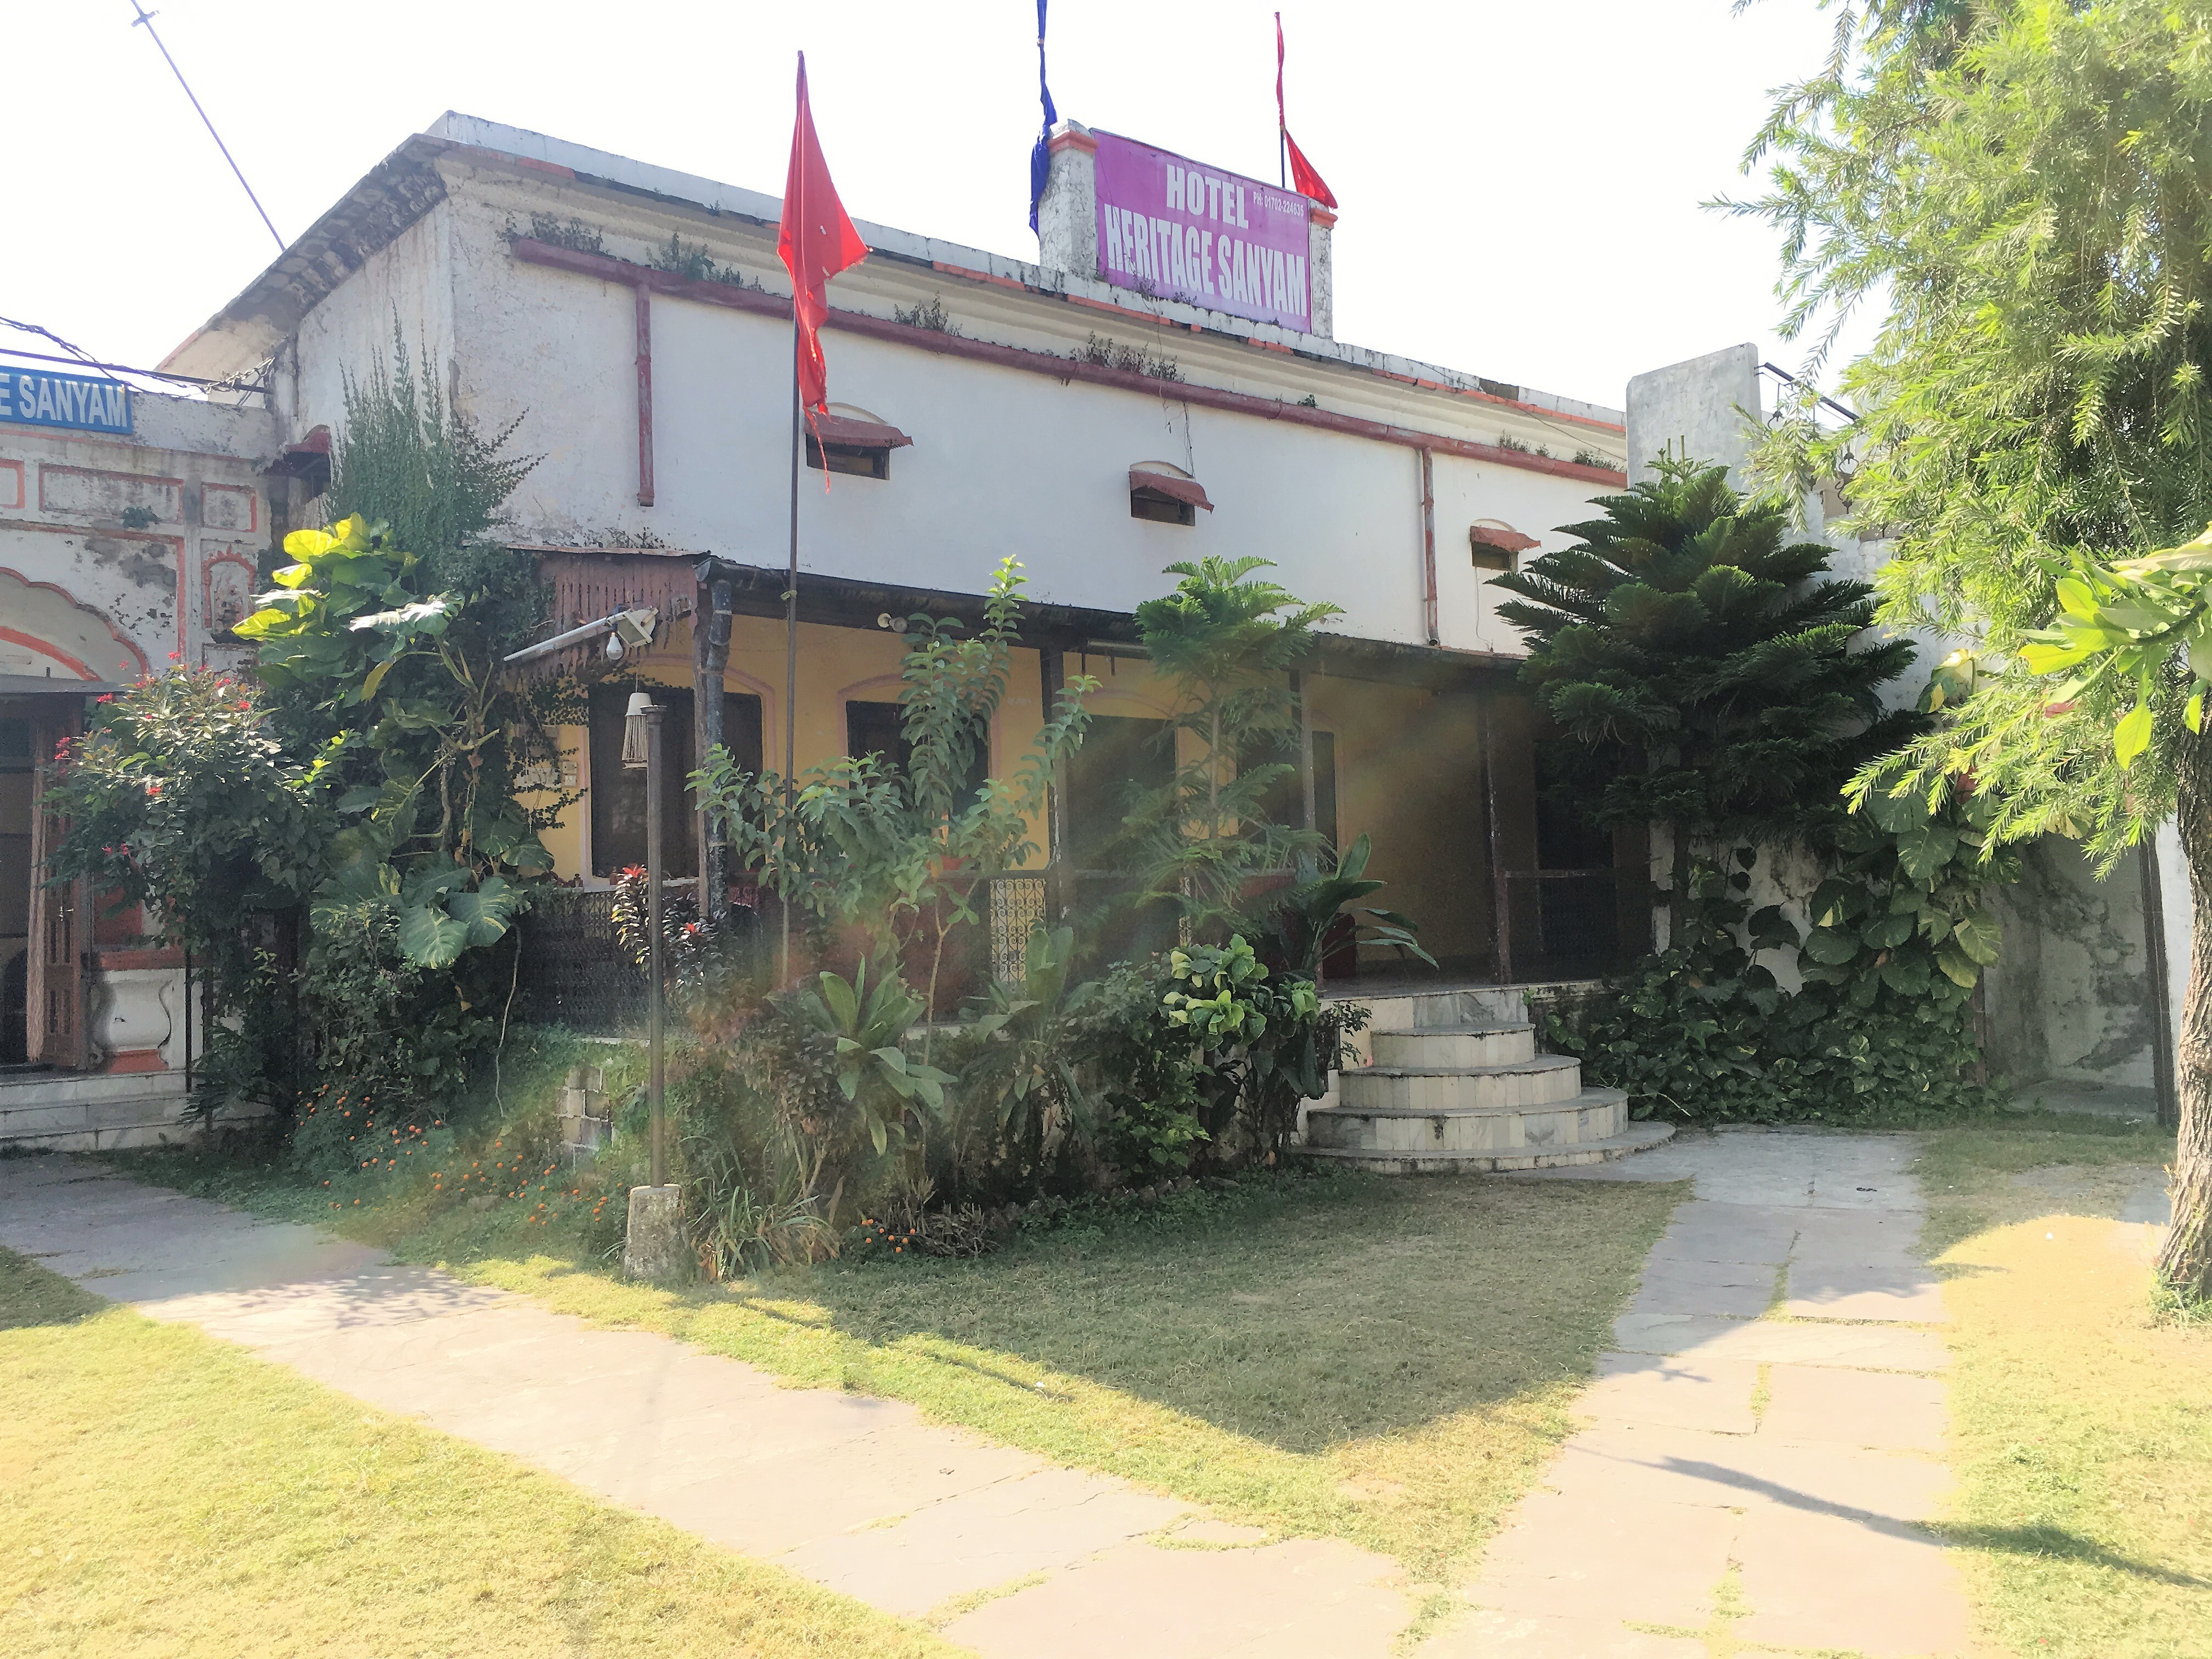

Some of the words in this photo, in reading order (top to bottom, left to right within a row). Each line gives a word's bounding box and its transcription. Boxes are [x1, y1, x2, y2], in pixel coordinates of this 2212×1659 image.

[1166, 163, 1249, 229] HOTEL
[1253, 191, 1263, 206] PH:
[1104, 204, 1215, 295] HERITAGE
[1218, 234, 1307, 317] SANYAM
[19, 375, 127, 427] SANYAM
